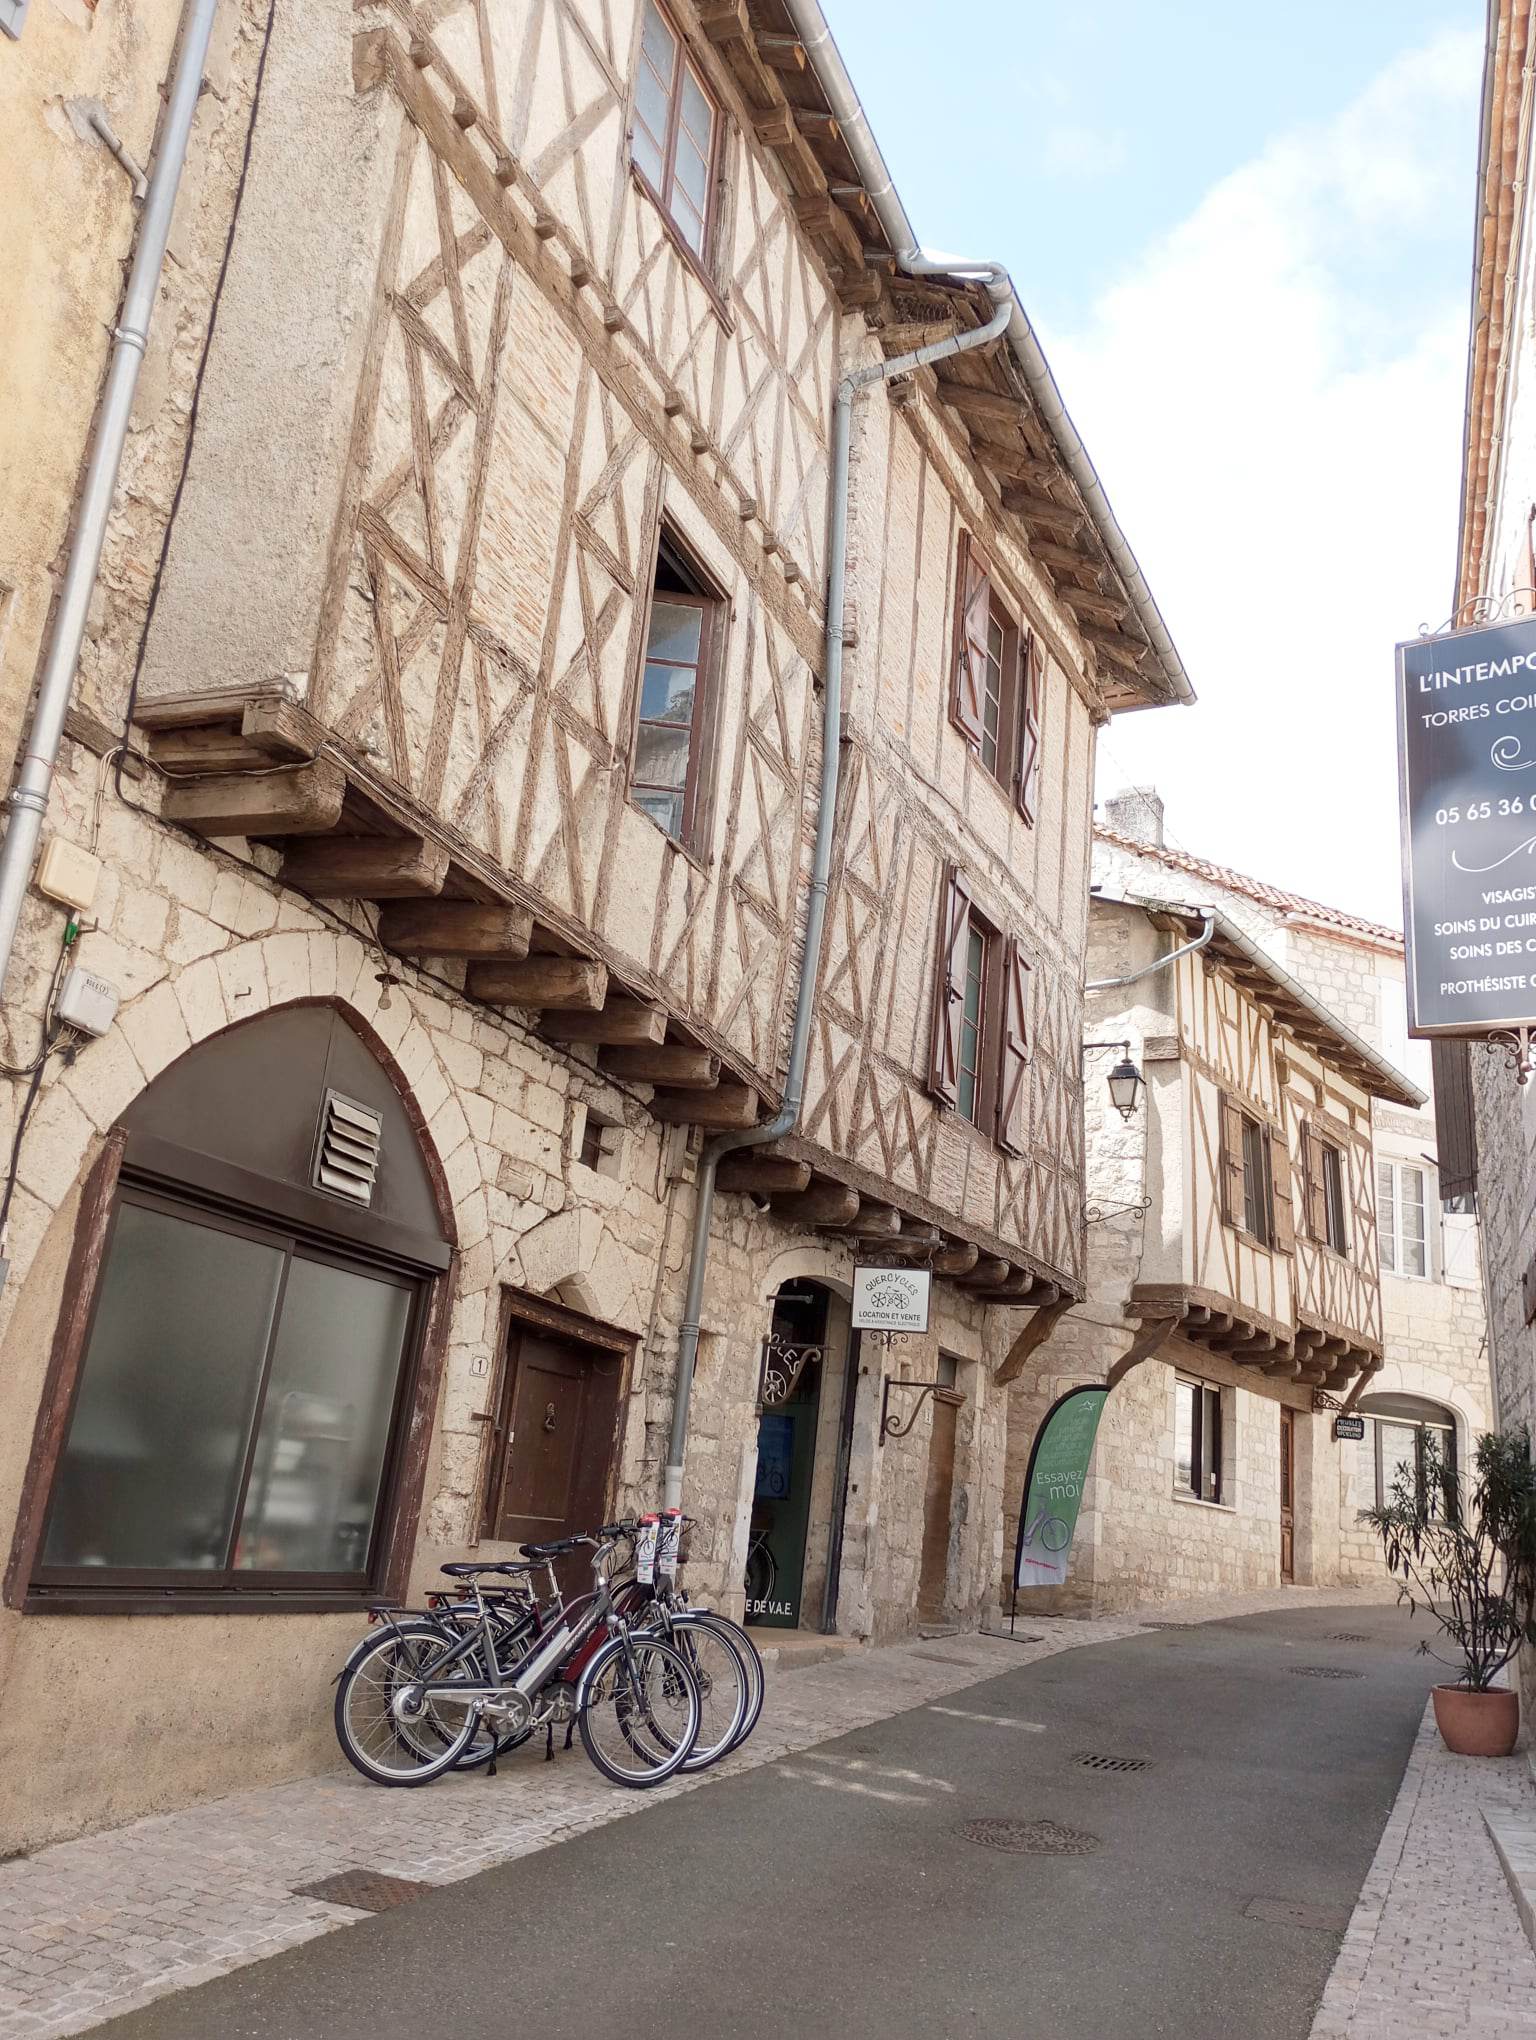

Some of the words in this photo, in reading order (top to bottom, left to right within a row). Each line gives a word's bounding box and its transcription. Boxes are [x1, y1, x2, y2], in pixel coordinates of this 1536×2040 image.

[1422, 703, 1490, 728] TORRES
[1435, 807, 1460, 825] 05
[1467, 802, 1491, 820] 65
[1498, 796, 1523, 816] 36
[1434, 919, 1476, 936] SOINS
[1479, 916, 1500, 931] DU
[1450, 943, 1492, 960] SOINS
[1496, 940, 1522, 955] DES
[1440, 975, 1526, 995] PROTHÉSISTE
[865, 1273, 918, 1296] QUERCYCLES
[858, 1311, 890, 1320] LOCATION
[891, 1312, 899, 1320] ET
[901, 1313, 921, 1321] VENTE
[478, 1359, 483, 1373] 1
[1036, 1470, 1083, 1485] Essayez
[1049, 1480, 1080, 1500] moi
[753, 1600, 767, 1613] DE
[768, 1600, 793, 1616] V.A.E.
